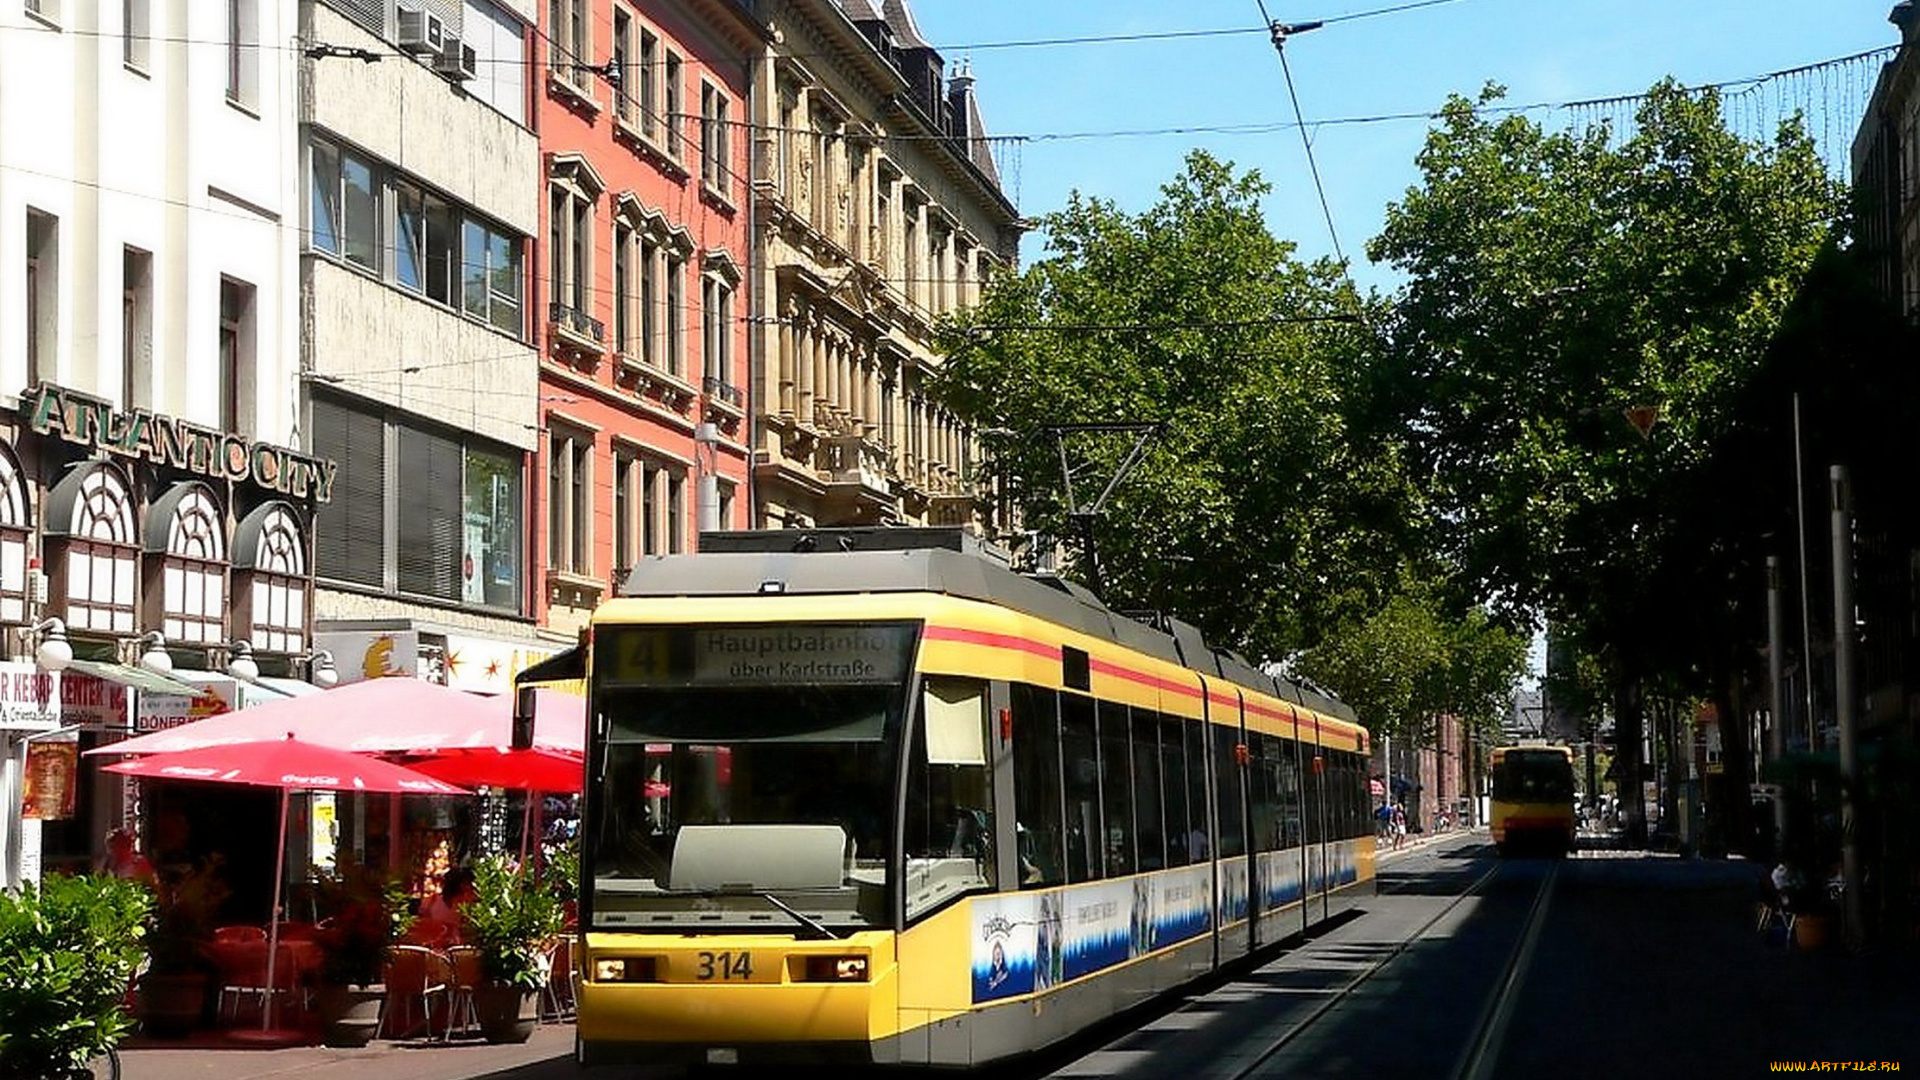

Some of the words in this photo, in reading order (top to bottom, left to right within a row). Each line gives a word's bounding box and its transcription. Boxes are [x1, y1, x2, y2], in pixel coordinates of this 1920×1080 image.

[32, 381, 250, 482] ATLANTIC
[251, 441, 337, 502] CITY
[628, 633, 656, 674] 4
[707, 630, 892, 657] Hauptbahnho
[730, 660, 772, 678] über
[778, 659, 875, 678] Karlstraße
[14, 673, 54, 704] KEBAP
[60, 673, 104, 706] CENTER
[697, 950, 754, 979] 314
